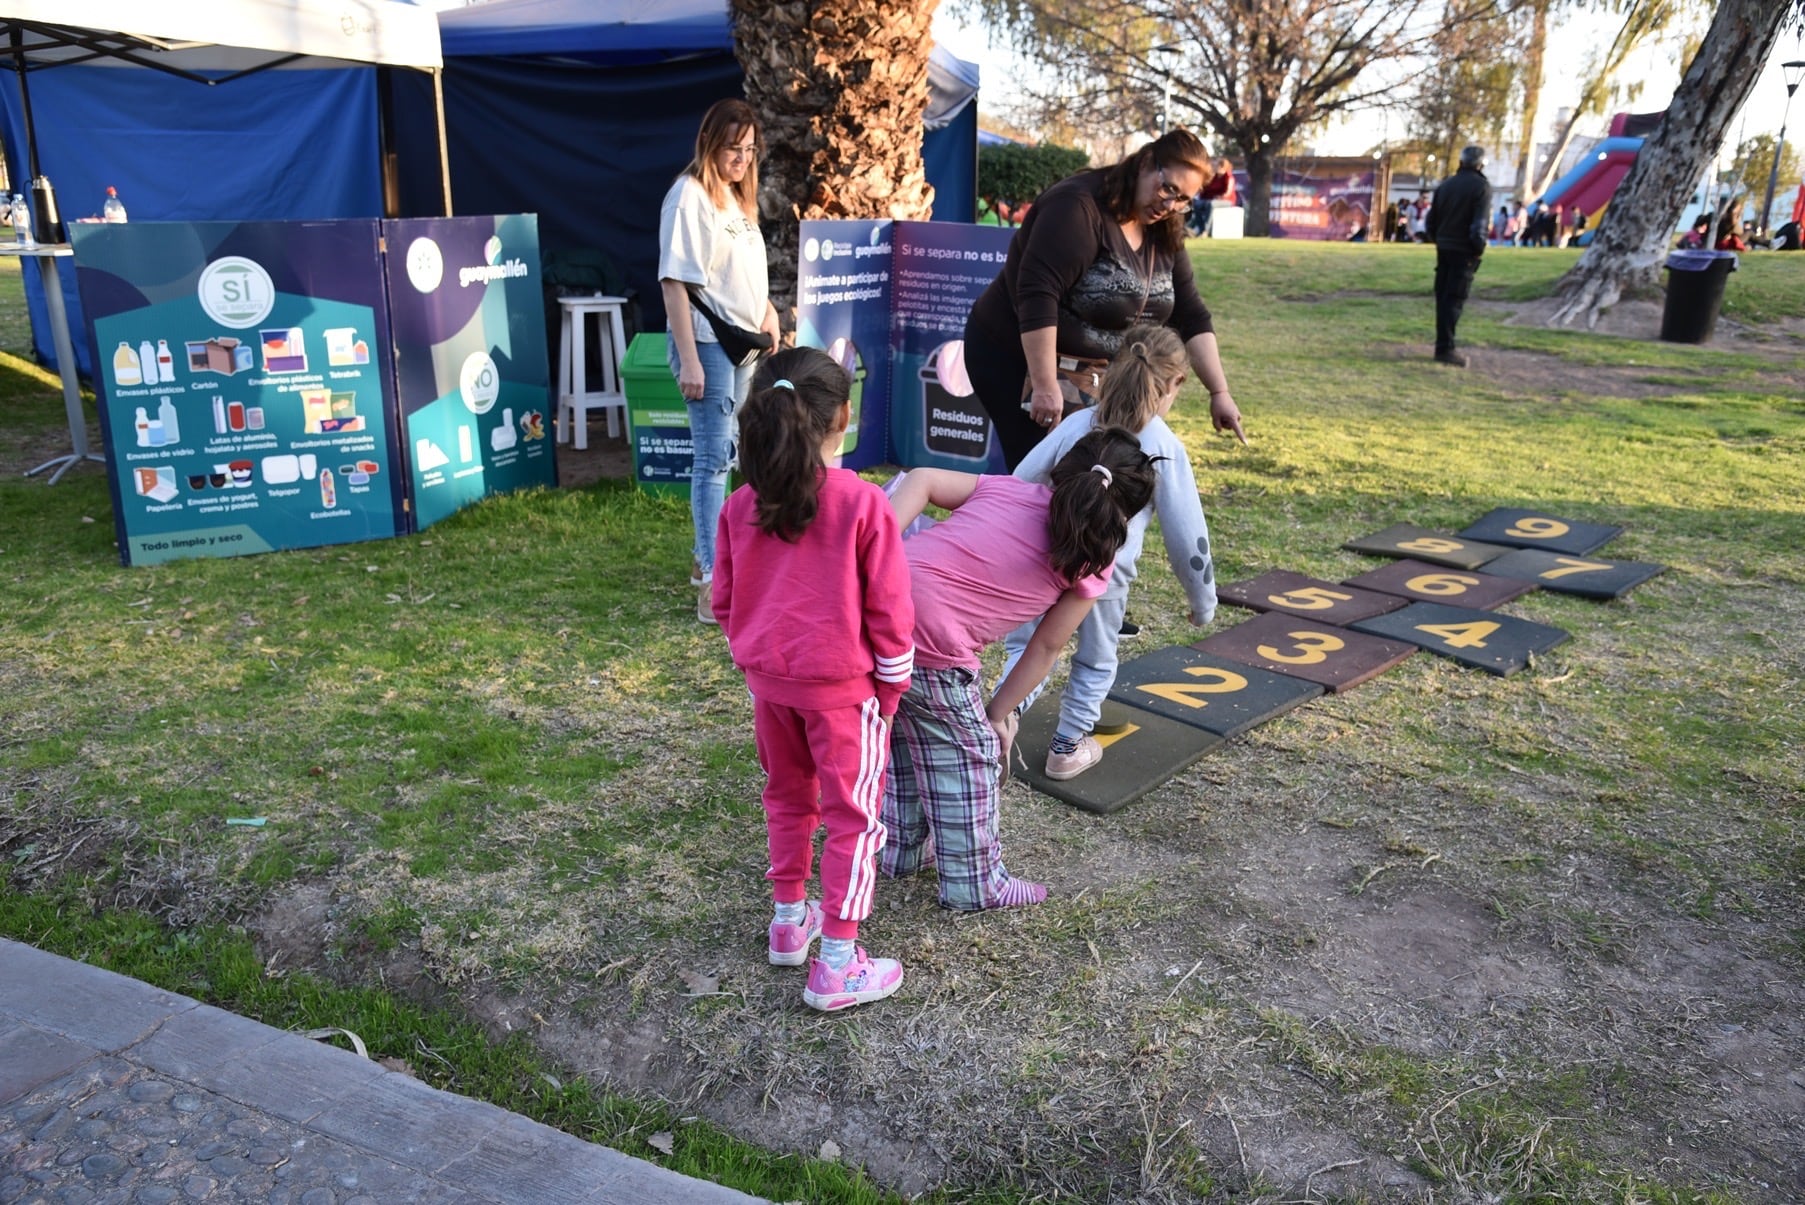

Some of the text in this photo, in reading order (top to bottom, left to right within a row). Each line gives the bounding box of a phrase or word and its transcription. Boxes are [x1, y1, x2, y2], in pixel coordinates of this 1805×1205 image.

[914, 247, 925, 256] se
[927, 248, 961, 260] separa
[964, 251, 978, 260] no
[981, 252, 994, 262] es
[847, 272, 879, 287] participar
[880, 270, 888, 281] de
[899, 280, 929, 289] residuos
[951, 274, 972, 283] sobre
[974, 277, 994, 286] sepa
[804, 292, 816, 305] los
[817, 291, 843, 306] juegos
[930, 293, 940, 302] las
[291, 374, 323, 384] plásticos
[116, 386, 185, 397] Envases plásticos
[191, 382, 218, 390] Cartón
[932, 407, 984, 426] Residuos
[210, 437, 231, 445] Latas
[232, 435, 242, 443] de
[930, 425, 984, 443] generales
[204, 444, 235, 454] hojalata
[243, 441, 278, 450] aerosoles
[290, 440, 331, 449] Envoltorios
[351, 443, 375, 452] snacks
[640, 436, 649, 446] Si
[651, 438, 661, 446] se
[126, 448, 195, 461] Envases de vidrio
[640, 446, 653, 454] no
[654, 446, 665, 454] es
[268, 487, 300, 497] Telgopor
[349, 485, 370, 494] Tapas
[187, 498, 218, 506] Envases
[220, 495, 229, 503] de
[199, 505, 223, 513] crema
[231, 501, 259, 511] postres
[1505, 517, 1570, 538] 9
[141, 533, 243, 552] Todo limpio y seco
[1396, 537, 1465, 554] 8
[1538, 557, 1614, 580] 7
[1405, 573, 1481, 596] 6
[1268, 586, 1353, 610] 5
[1413, 620, 1502, 649] 4
[1256, 631, 1345, 665] 3
[1135, 666, 1249, 709] 2
